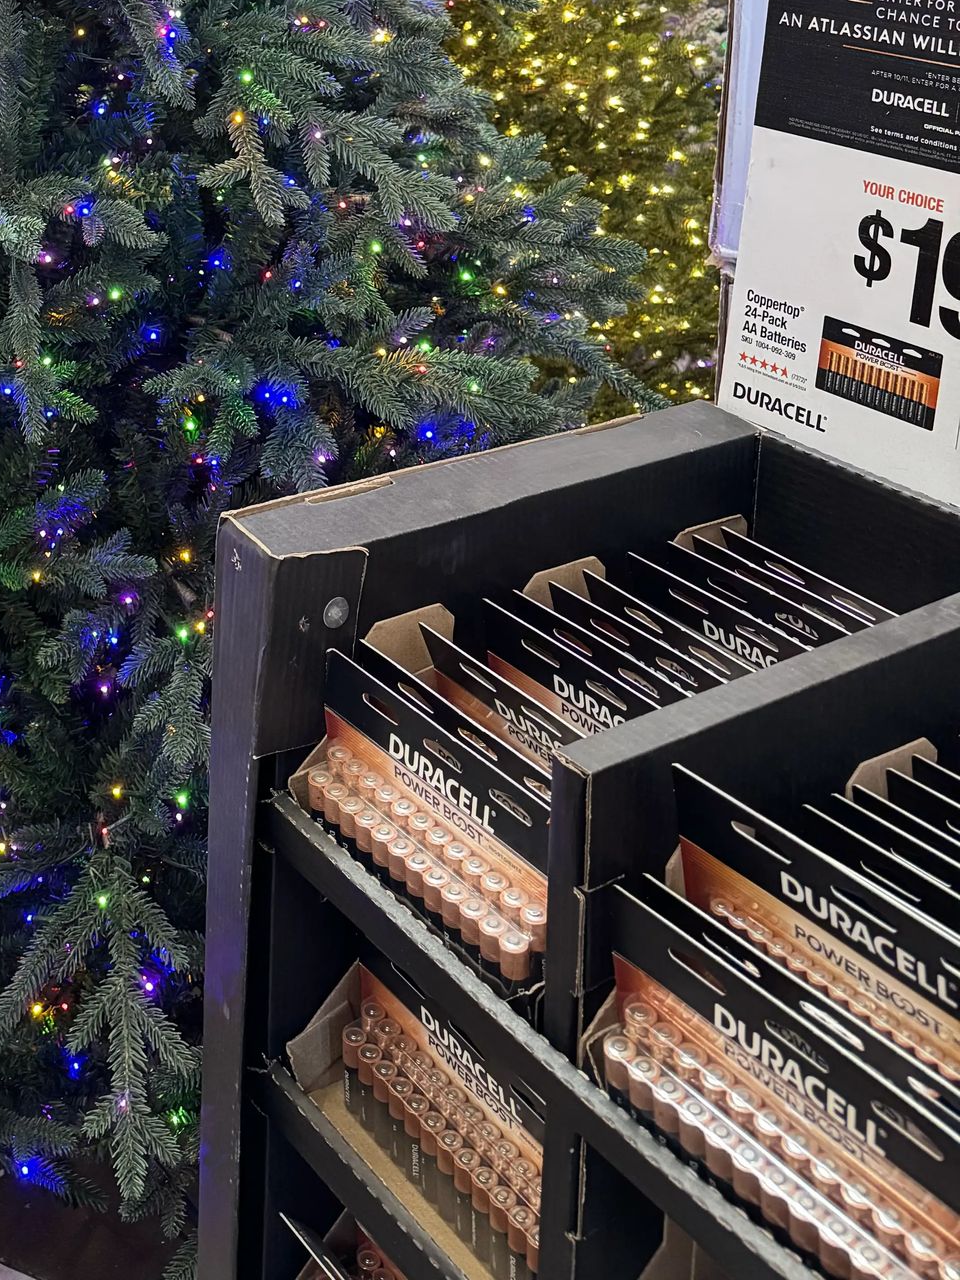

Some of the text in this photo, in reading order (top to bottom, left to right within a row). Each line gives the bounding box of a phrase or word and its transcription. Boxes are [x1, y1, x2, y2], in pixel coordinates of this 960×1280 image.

[876, 7, 941, 28] CHANCE
[779, 12, 960, 57] AN ATLASSIAN WILL
[872, 70, 892, 80] AFTER
[912, 77, 934, 87] ENTER
[935, 81, 949, 90] FOR
[872, 88, 950, 117] DURACELL
[871, 125, 957, 151] See terms and conditions
[924, 123, 954, 135] OFFICIAL
[863, 180, 944, 213] YOUR CHOICE
[744, 305, 788, 330] 24-Pack
[741, 335, 753, 345] SKU
[743, 320, 807, 353] AA Batteries
[854, 340, 905, 366] DURACELL
[389, 733, 495, 835] DURACELL
[394, 765, 441, 813] POWER
[443, 804, 483, 844] BOOST
[780, 871, 958, 1009] DURACELL
[794, 924, 944, 1035] POWER BOOST
[421, 1005, 522, 1124] DURACELL
[714, 1003, 886, 1157] DURACELL
[724, 1039, 802, 1112] POWER
[428, 1035, 513, 1129] POWER BOOST
